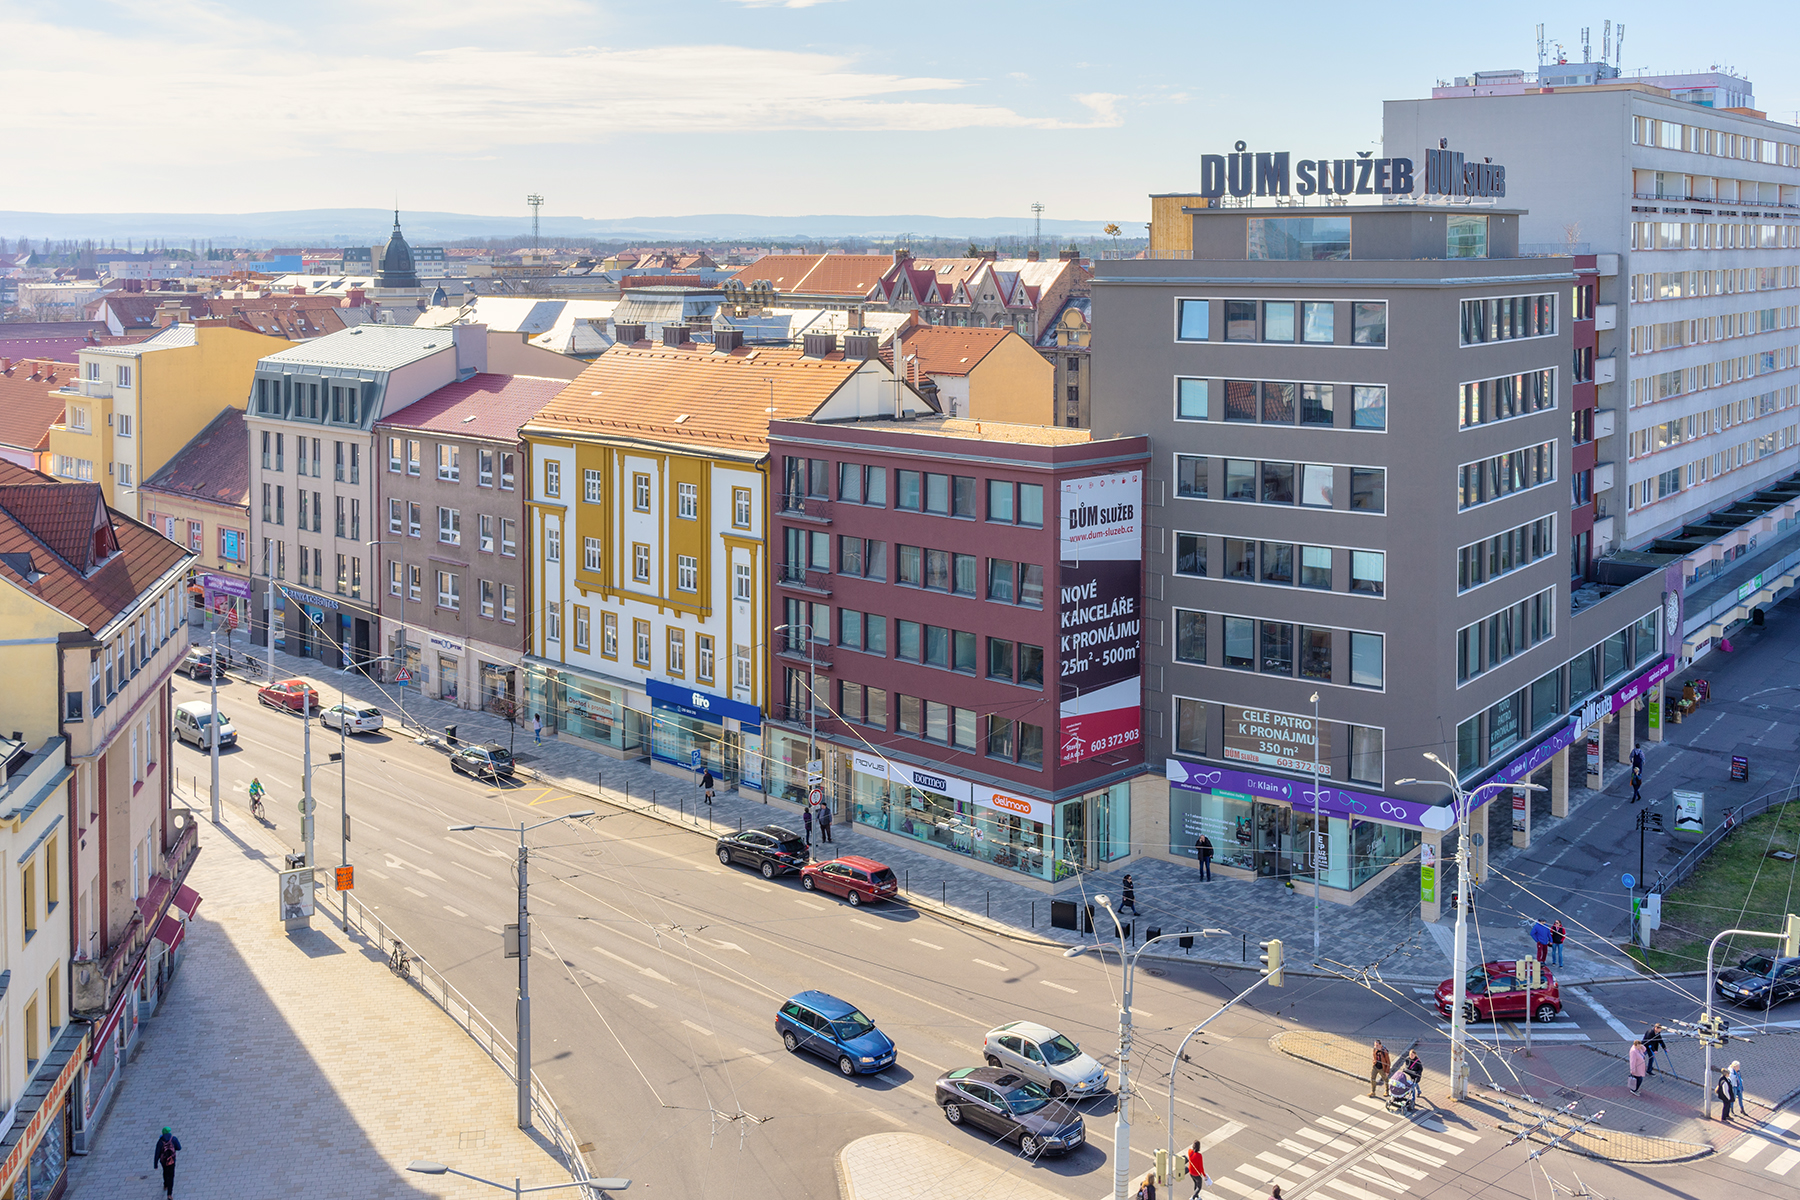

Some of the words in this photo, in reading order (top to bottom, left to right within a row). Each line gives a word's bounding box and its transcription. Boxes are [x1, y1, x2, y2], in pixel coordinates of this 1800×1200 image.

[1201, 140, 1290, 198] DŮM
[1296, 151, 1414, 195] SLUŽEB
[1425, 137, 1464, 196] DŮM
[1464, 157, 1506, 198] SLUŽEB
[1070, 501, 1098, 529] DŮM
[1100, 503, 1134, 525] SLUŽEB
[1069, 526, 1133, 542] www.dum-sluzeb.cz
[288, 591, 308, 602] BANKA
[309, 595, 339, 610] CREDITAS
[1061, 579, 1097, 604] NOVÉ
[1061, 596, 1134, 629] KANCELÁŘE
[1061, 635, 1070, 652] K
[1073, 619, 1140, 650] PRONÁJMU
[1499, 698, 1510, 713] TOTO
[1242, 710, 1270, 724] CELÉ
[1274, 714, 1312, 730] PATRO
[1494, 718, 1517, 741] PRONÁJMU
[1498, 710, 1511, 726] PATRO
[1091, 738, 1106, 752] 603
[1108, 733, 1123, 747] 372
[1124, 728, 1139, 742] 903
[1239, 723, 1247, 735] K
[1250, 725, 1316, 746] PRONÁJMU
[1259, 741, 1280, 754] 350
[1283, 746, 1299, 756] m²
[855, 757, 885, 772] NOVUS
[1225, 748, 1240, 759] DŮM
[1241, 753, 1259, 762] SLUŽEB
[1276, 758, 1293, 768] 603
[1295, 761, 1311, 771] 372
[1313, 764, 1331, 775] 03
[994, 796, 1029, 813] delimano
[26, 1111, 40, 1148] PRO
